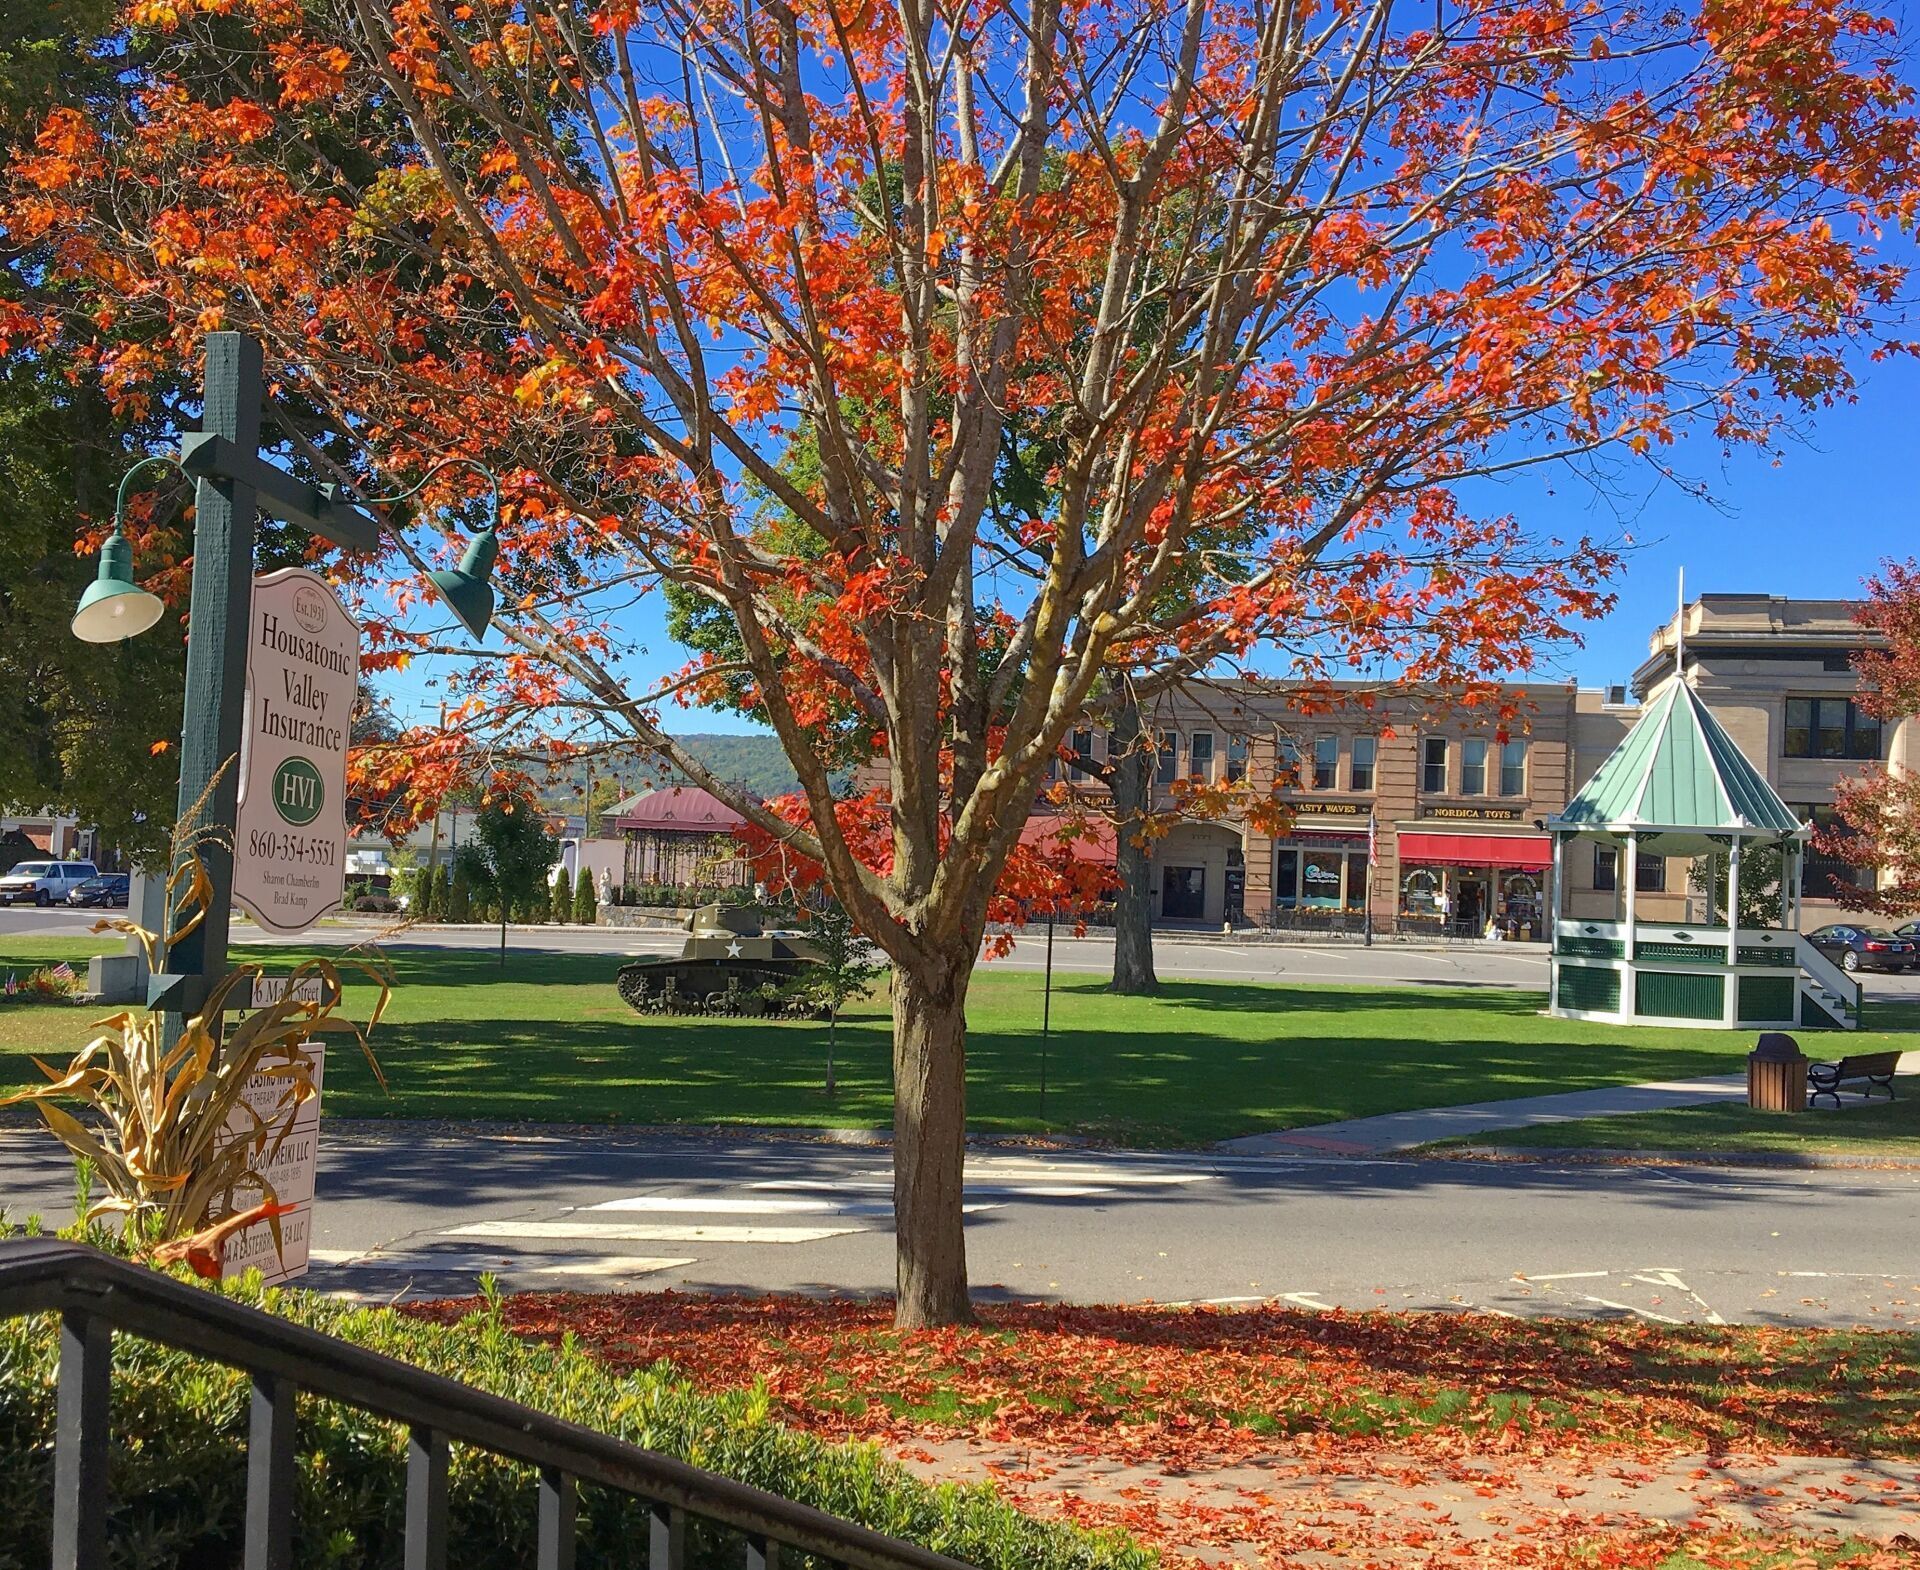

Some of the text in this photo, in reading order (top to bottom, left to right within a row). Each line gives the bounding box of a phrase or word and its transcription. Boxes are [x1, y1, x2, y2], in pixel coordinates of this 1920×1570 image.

[261, 611, 351, 676] Housatonic
[283, 667, 329, 722] Valley
[260, 697, 342, 752] Insurance
[281, 772, 316, 809] HVI
[1296, 803, 1356, 814] TASTY WAVES
[1434, 808, 1511, 819] NORDICA TOYS
[249, 829, 336, 866] 860-354-5551
[262, 870, 320, 889] Sharon Chamberlin
[273, 890, 308, 910] Brad Kamp
[276, 1143, 295, 1167] REIKI
[296, 1140, 310, 1162] LLC
[294, 1219, 304, 1242] LLC
